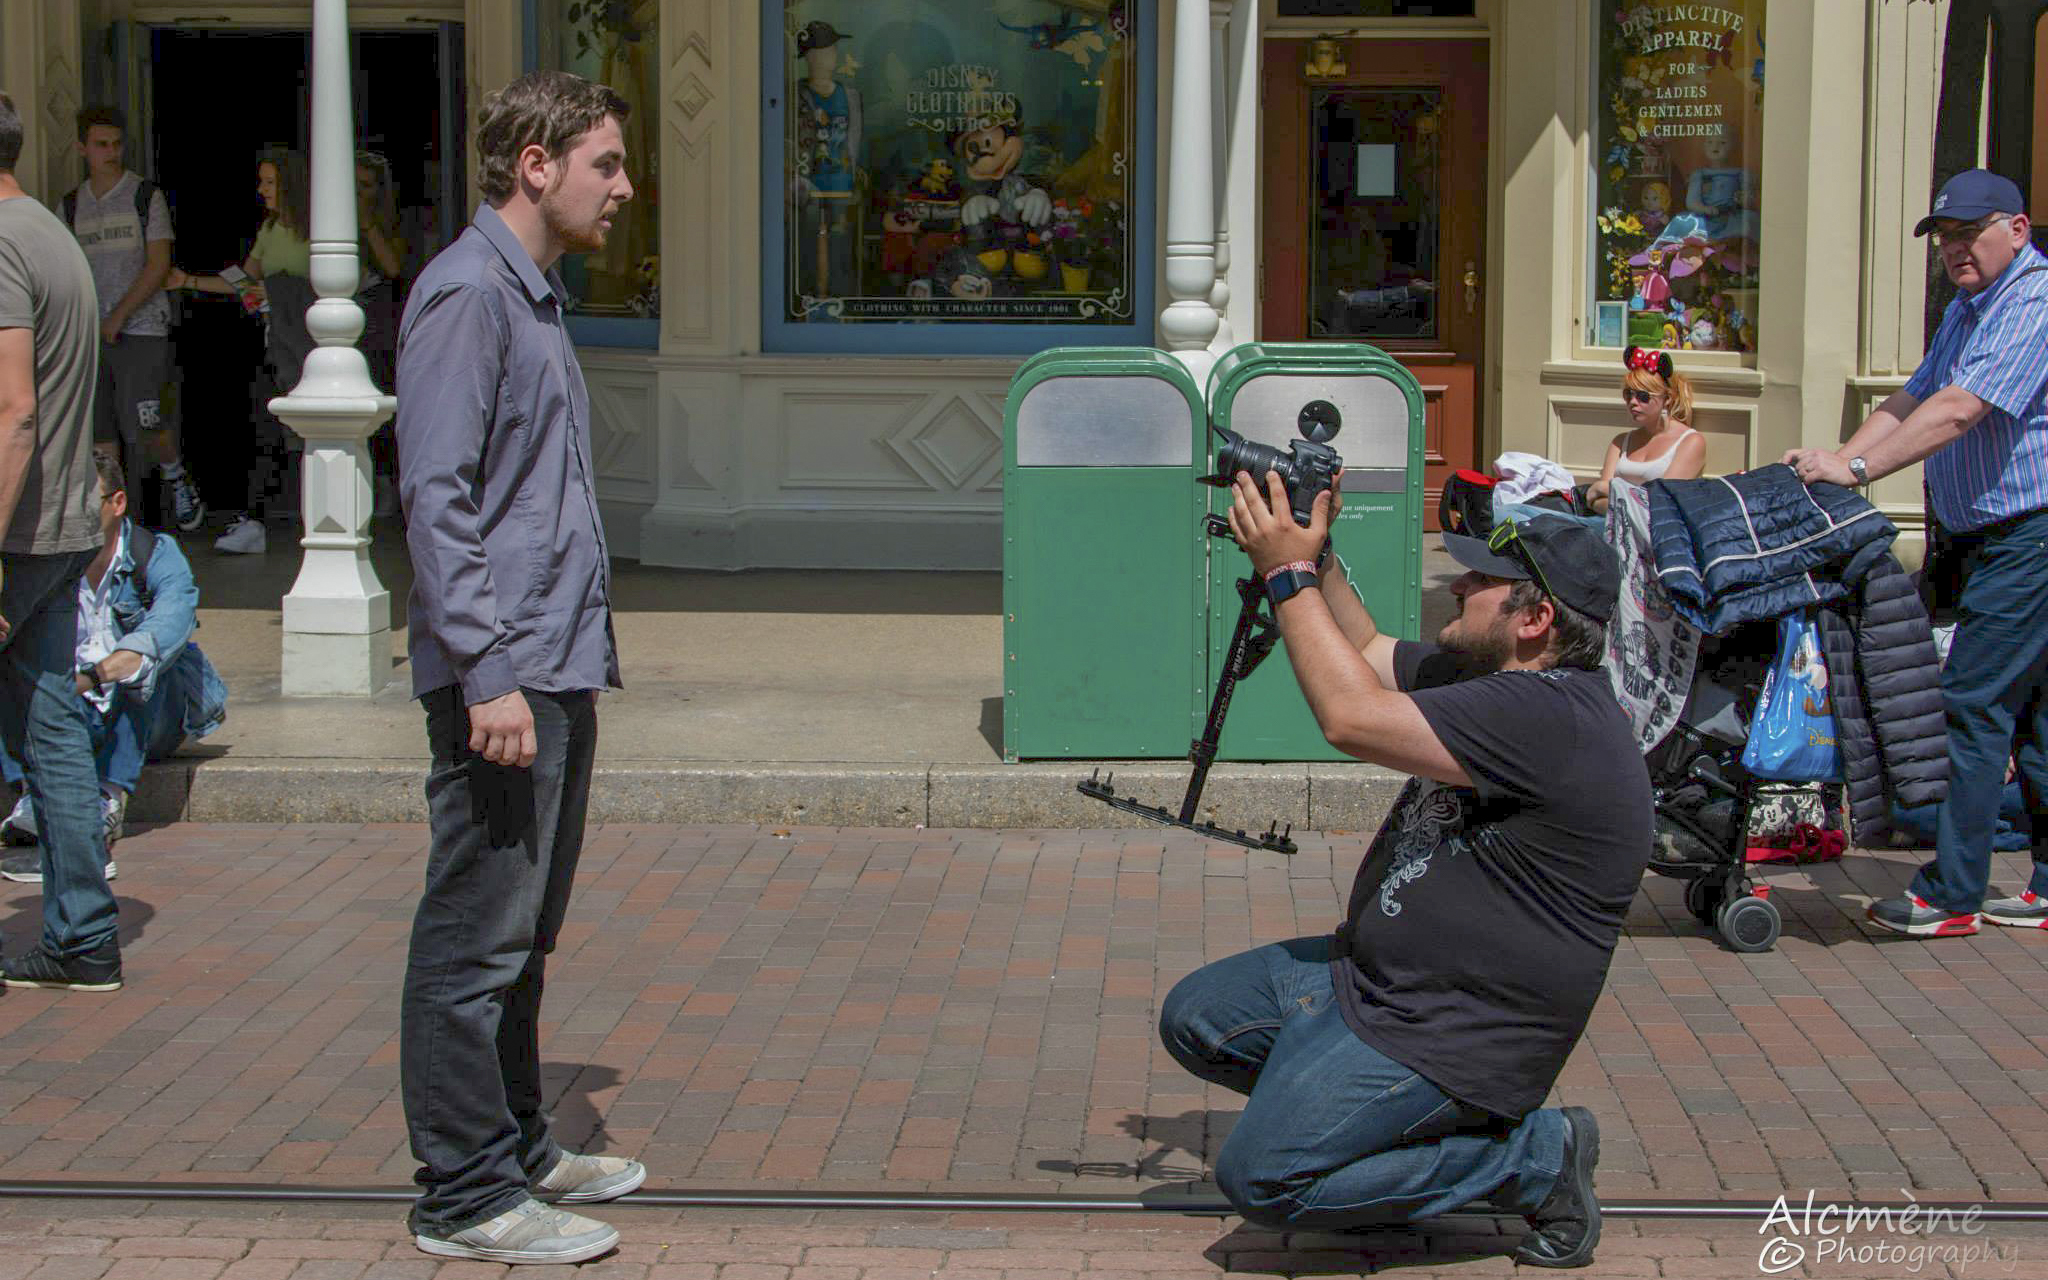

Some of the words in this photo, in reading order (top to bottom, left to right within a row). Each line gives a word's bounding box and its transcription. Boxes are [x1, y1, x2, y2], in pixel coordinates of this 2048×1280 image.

[1621, 5, 1744, 37] DISTINCTIVE
[1641, 30, 1725, 54] APPAREL
[1668, 62, 1696, 75] FOR
[927, 64, 999, 88] DISNEY
[1656, 85, 1708, 99] LADIES
[906, 91, 1016, 113] CLOTHIERS
[1639, 104, 1723, 118] GENTLEMEN
[1639, 125, 1648, 137] &
[1653, 123, 1723, 137] CHILDREN
[853, 303, 906, 313] CLOTHING
[912, 303, 940, 313] WITH
[1013, 303, 1044, 313] SINCE
[1354, 503, 1394, 513] uniquement
[1349, 512, 1363, 521] only
